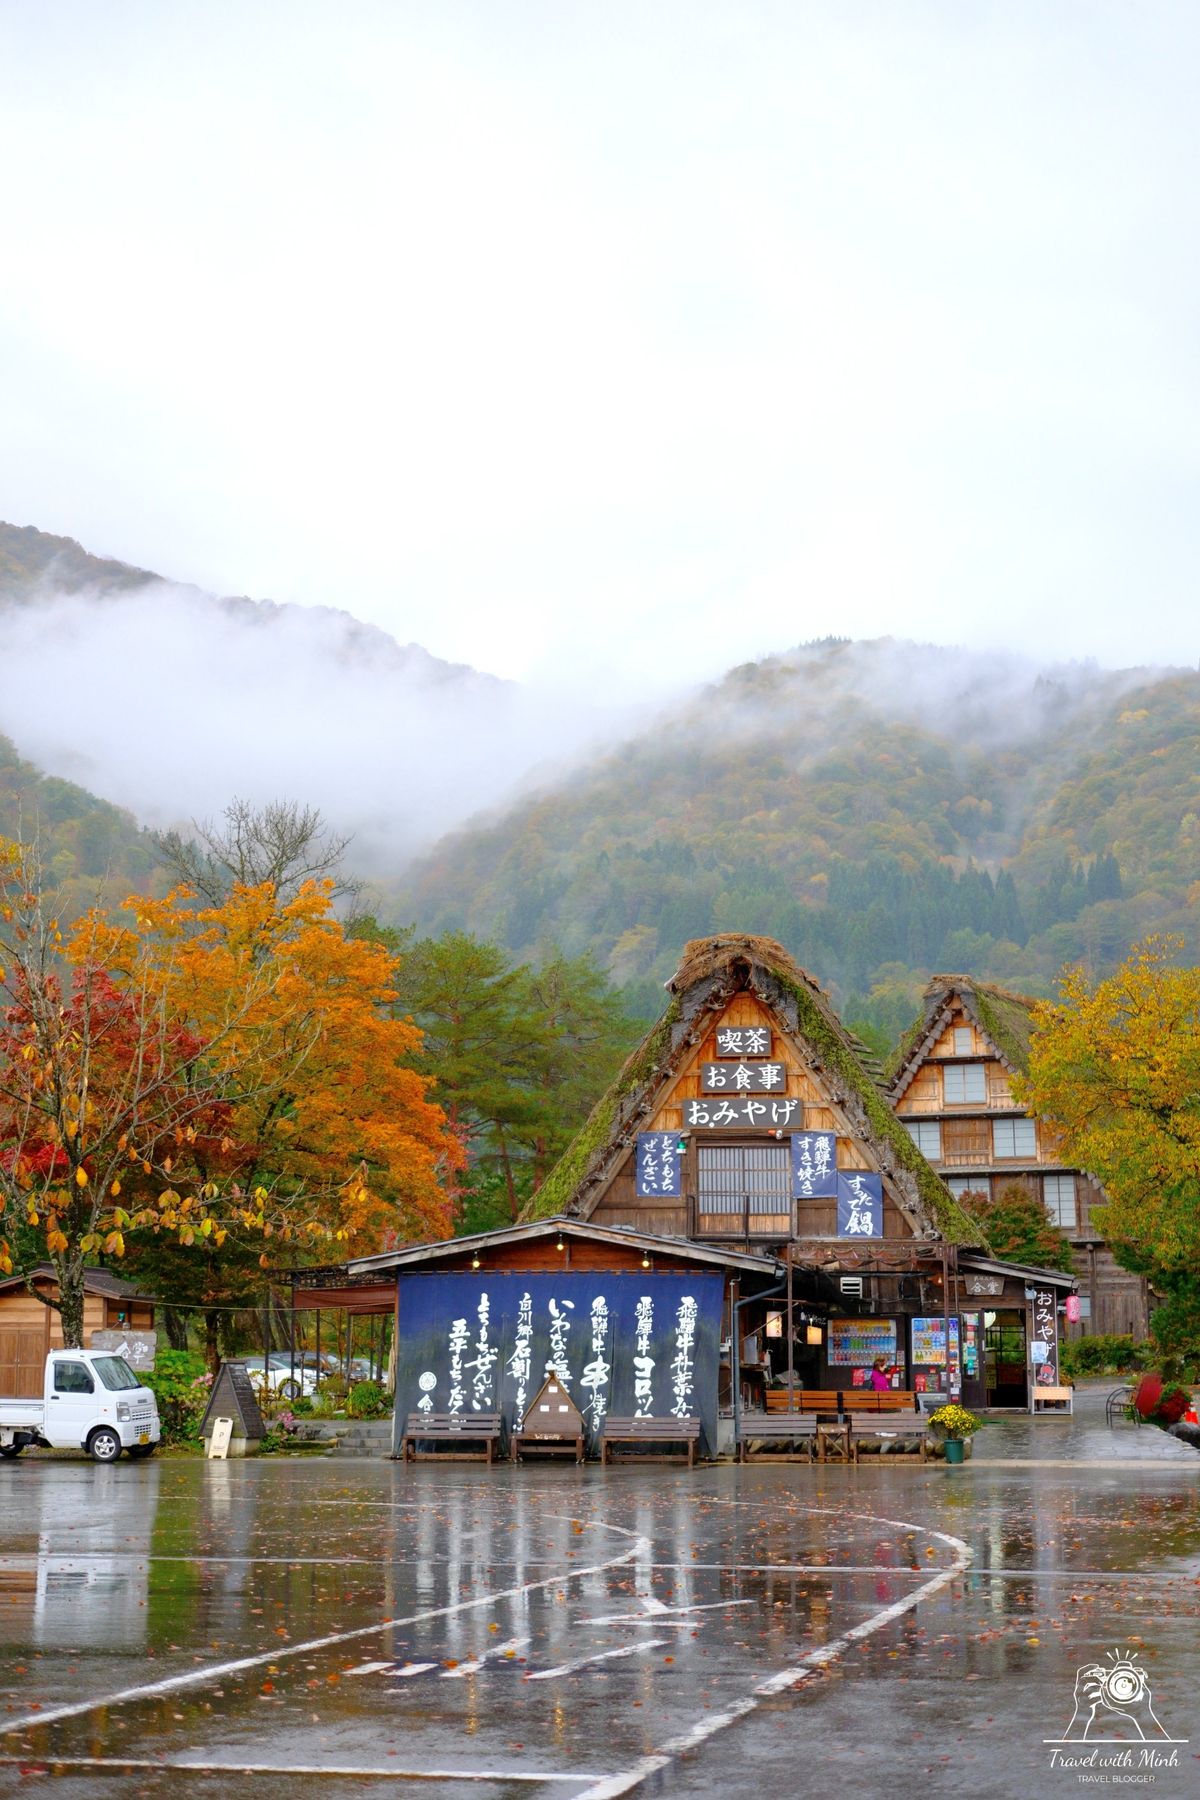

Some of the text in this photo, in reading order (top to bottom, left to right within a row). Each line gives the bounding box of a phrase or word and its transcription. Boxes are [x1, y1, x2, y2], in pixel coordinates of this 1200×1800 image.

[717, 1028, 768, 1054] 喫茶
[707, 1064, 781, 1090] お食事
[688, 1100, 798, 1126] おみやげ
[642, 1138, 658, 1194] ぜんざい
[661, 1135, 674, 1192] とちもち
[798, 1137, 816, 1195] すき焼き
[814, 1136, 832, 1180] 飛騨牛
